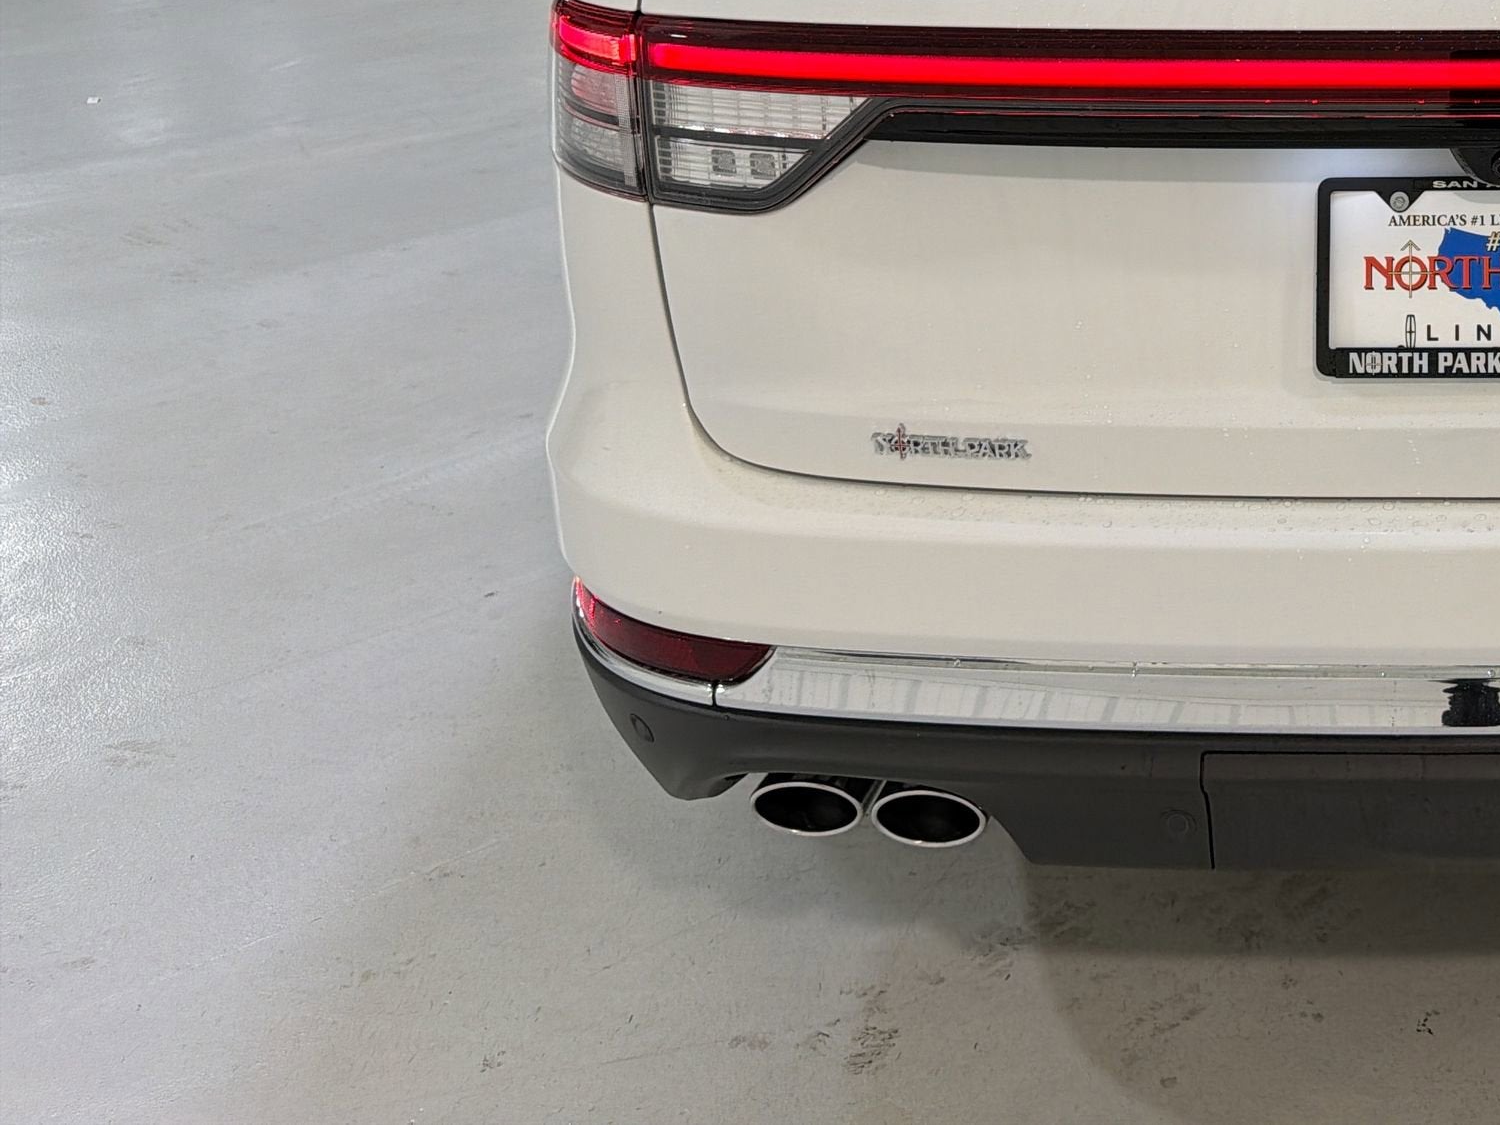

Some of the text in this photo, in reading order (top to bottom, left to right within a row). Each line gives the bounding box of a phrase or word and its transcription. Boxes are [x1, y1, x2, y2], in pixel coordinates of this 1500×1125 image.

[1432, 179, 1478, 189] SAN
[1388, 214, 1467, 227] AMERICA'S
[1470, 215, 1485, 227] #1
[1349, 351, 1429, 374] NORTH
[871, 429, 1032, 460] NORTH PARK
